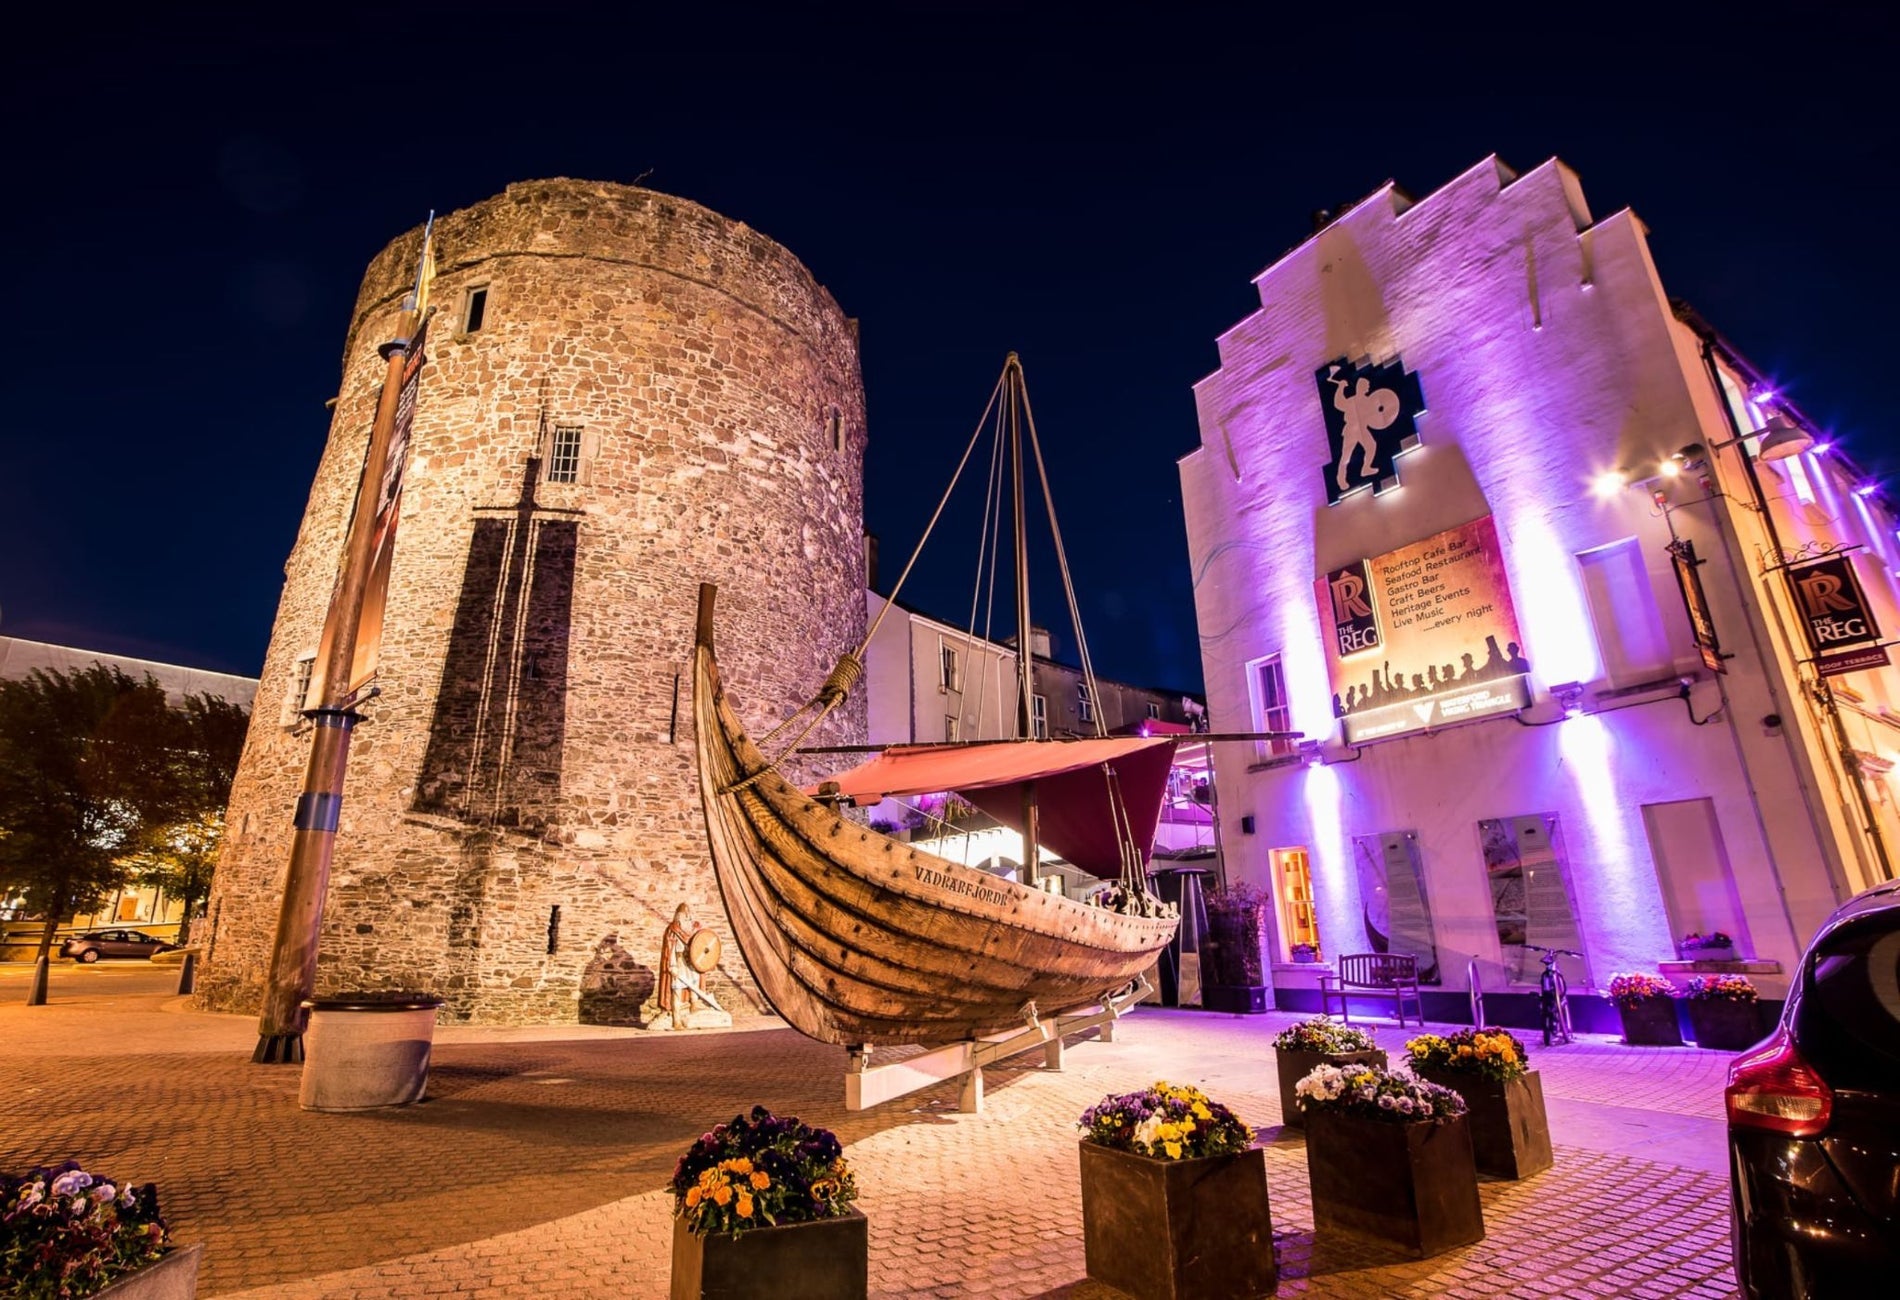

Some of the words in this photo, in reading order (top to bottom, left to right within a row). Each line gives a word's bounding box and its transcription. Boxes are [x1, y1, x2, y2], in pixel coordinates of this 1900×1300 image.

[1383, 557, 1420, 575] Rooftop
[1423, 547, 1445, 560] Cafe
[1449, 540, 1468, 551] Bar
[1385, 566, 1421, 586] Seafood
[1426, 545, 1482, 571] Restaurant
[1387, 581, 1418, 596] Gastro
[1422, 573, 1439, 584] Bar
[1389, 594, 1413, 607] Craft
[1417, 584, 1445, 598] Beers
[1391, 600, 1432, 617] Heritage
[1435, 587, 1470, 604] Events
[1466, 604, 1493, 618] night
[1393, 618, 1412, 629] Live
[1416, 607, 1444, 622] Music
[1811, 617, 1835, 627] THE
[1337, 624, 1355, 636] THE
[1340, 626, 1377, 654] REG
[1815, 619, 1867, 643] REG
[1844, 653, 1883, 665] TERRACE
